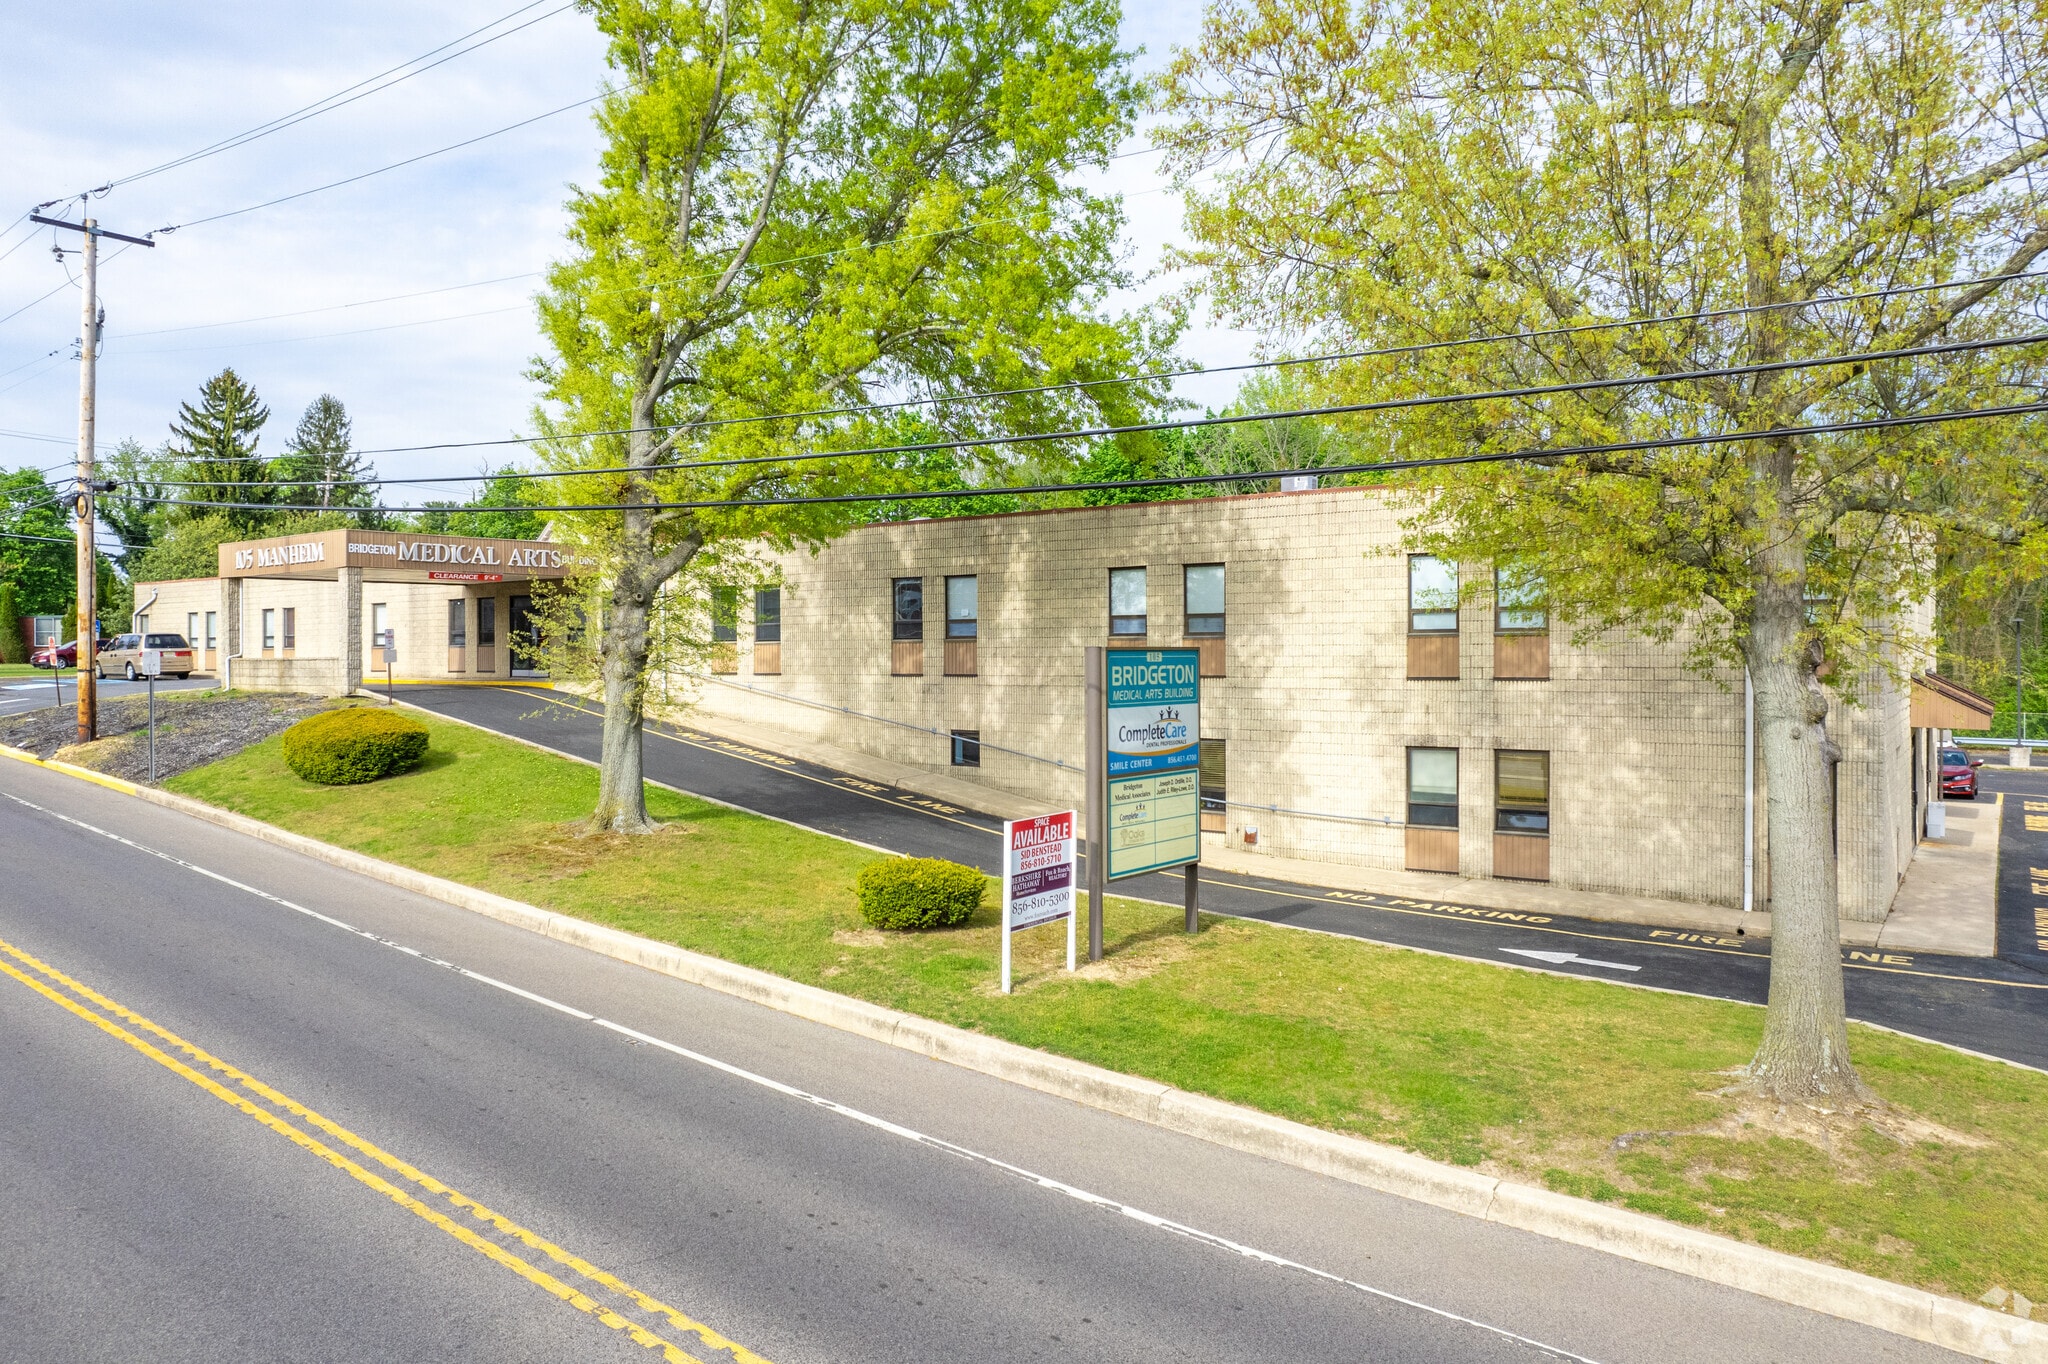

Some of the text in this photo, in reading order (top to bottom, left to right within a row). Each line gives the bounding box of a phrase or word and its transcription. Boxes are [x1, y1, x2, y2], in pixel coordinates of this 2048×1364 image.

[235, 541, 325, 569] 105 MANHEIM
[348, 543, 396, 555] BRIDGETON
[397, 541, 500, 565] MEDICAL
[508, 548, 561, 568] ARTS
[433, 572, 479, 580] CLEARANCE
[1111, 664, 1195, 686] BRIDGETON
[1113, 687, 1194, 701] MEDICAL ARTS BUILDING
[1119, 721, 1187, 744] CompleteCare
[675, 732, 796, 765] NO PARKING
[1110, 758, 1152, 771] SMILE CENTER
[832, 777, 966, 814] FIRE LANE
[1115, 791, 1151, 802] Medical Associates
[1123, 783, 1143, 792] Bridgeton
[1034, 817, 1050, 828] SPACE
[1013, 822, 1069, 850] AVAILABLE
[1020, 854, 1062, 870] 856-810-5710
[1021, 843, 1062, 860] SID BENSTEAD
[1012, 879, 1041, 892] HATHAWAY
[1012, 891, 1070, 916] 856-810-5300
[1325, 891, 1553, 924] NO PARKING
[1649, 930, 1914, 966] FIRE NE
